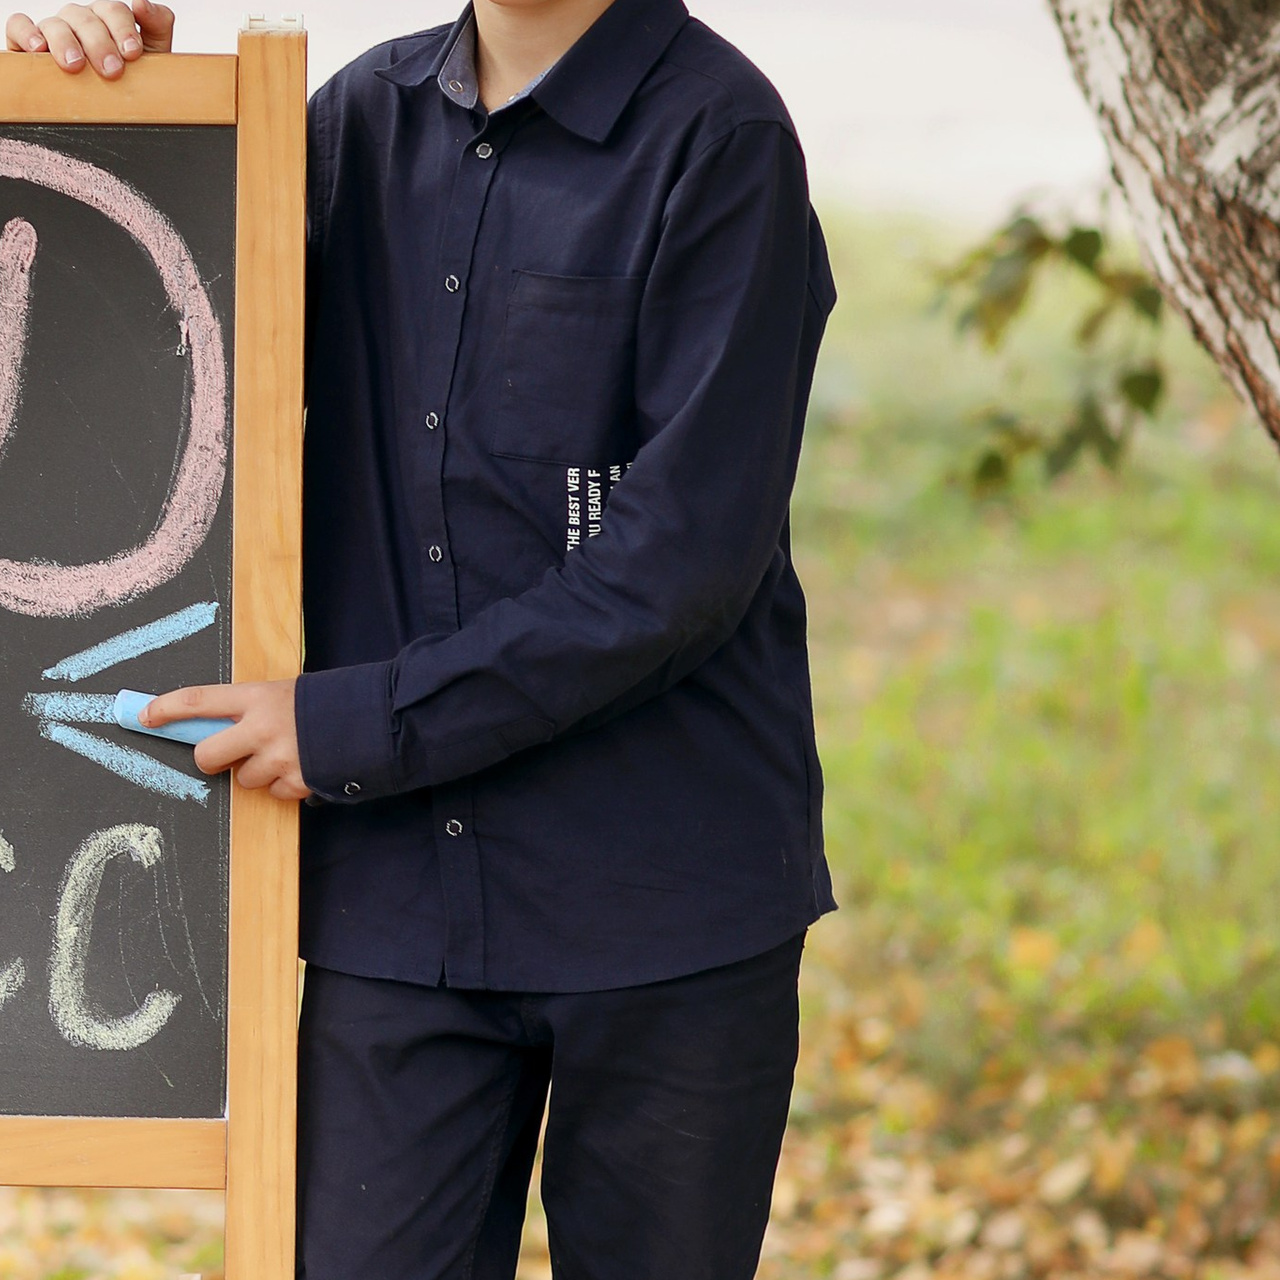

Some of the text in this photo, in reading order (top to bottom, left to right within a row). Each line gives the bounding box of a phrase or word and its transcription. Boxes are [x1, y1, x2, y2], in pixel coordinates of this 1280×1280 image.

[566, 467, 581, 552] THE BEST VER
[587, 480, 602, 521] READY
